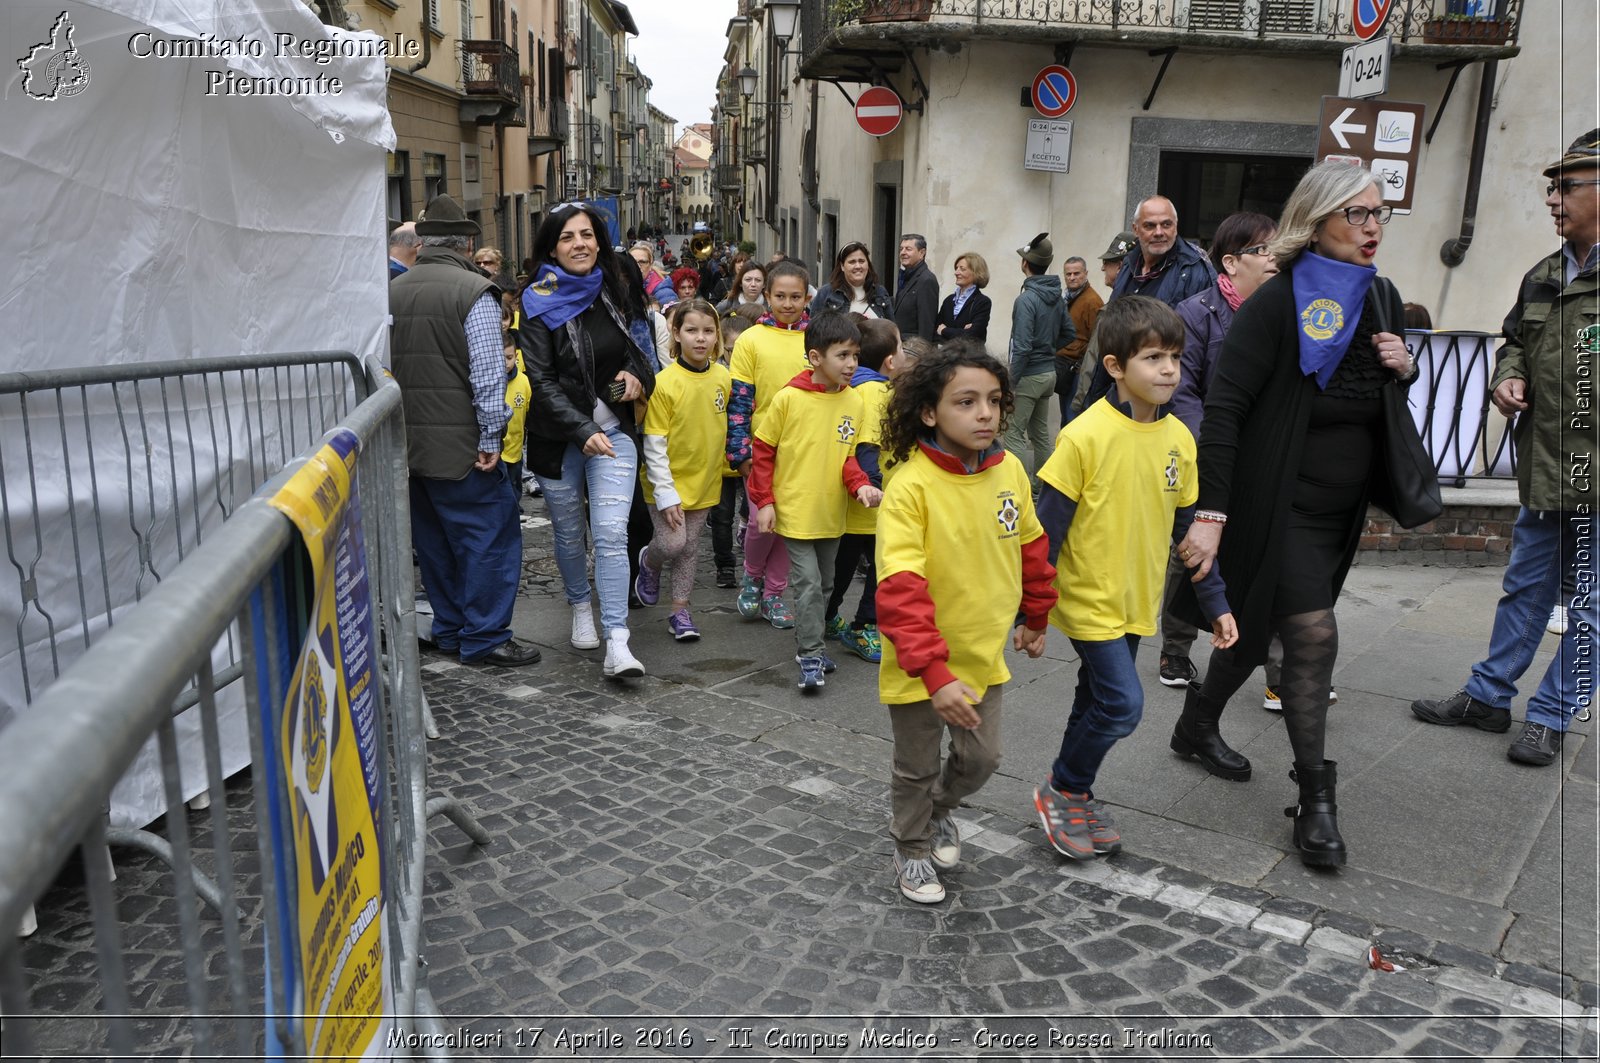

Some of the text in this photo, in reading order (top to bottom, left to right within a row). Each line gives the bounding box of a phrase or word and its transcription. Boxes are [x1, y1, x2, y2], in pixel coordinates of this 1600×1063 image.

[1355, 54, 1383, 82] 0-24
[1315, 301, 1341, 313] LIONS
[344, 963, 370, 1011] aprile
